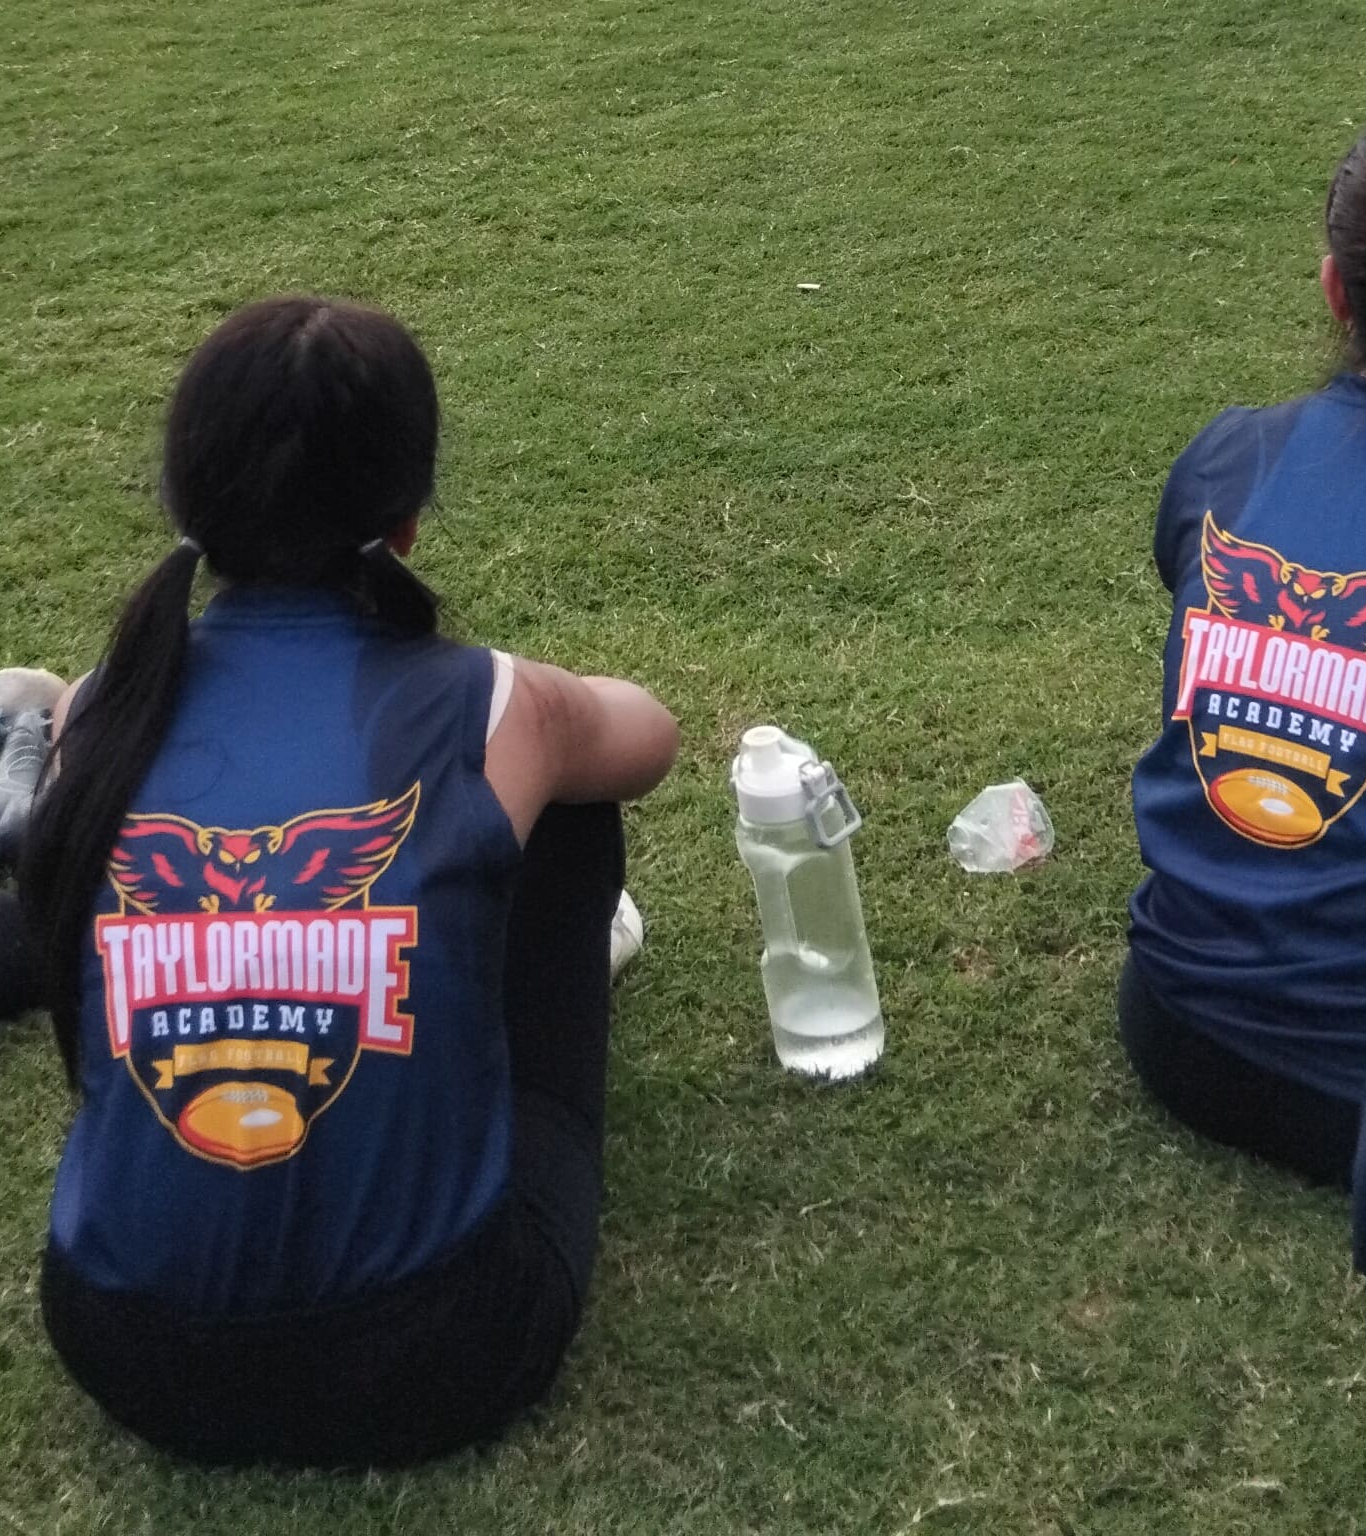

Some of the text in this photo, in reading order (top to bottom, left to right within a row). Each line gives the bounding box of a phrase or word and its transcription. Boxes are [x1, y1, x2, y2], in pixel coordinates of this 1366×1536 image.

[1207, 693, 1357, 753] ACADEMY
[103, 919, 406, 1043] TAYLORMADE
[151, 1004, 334, 1037] ACADEMY
